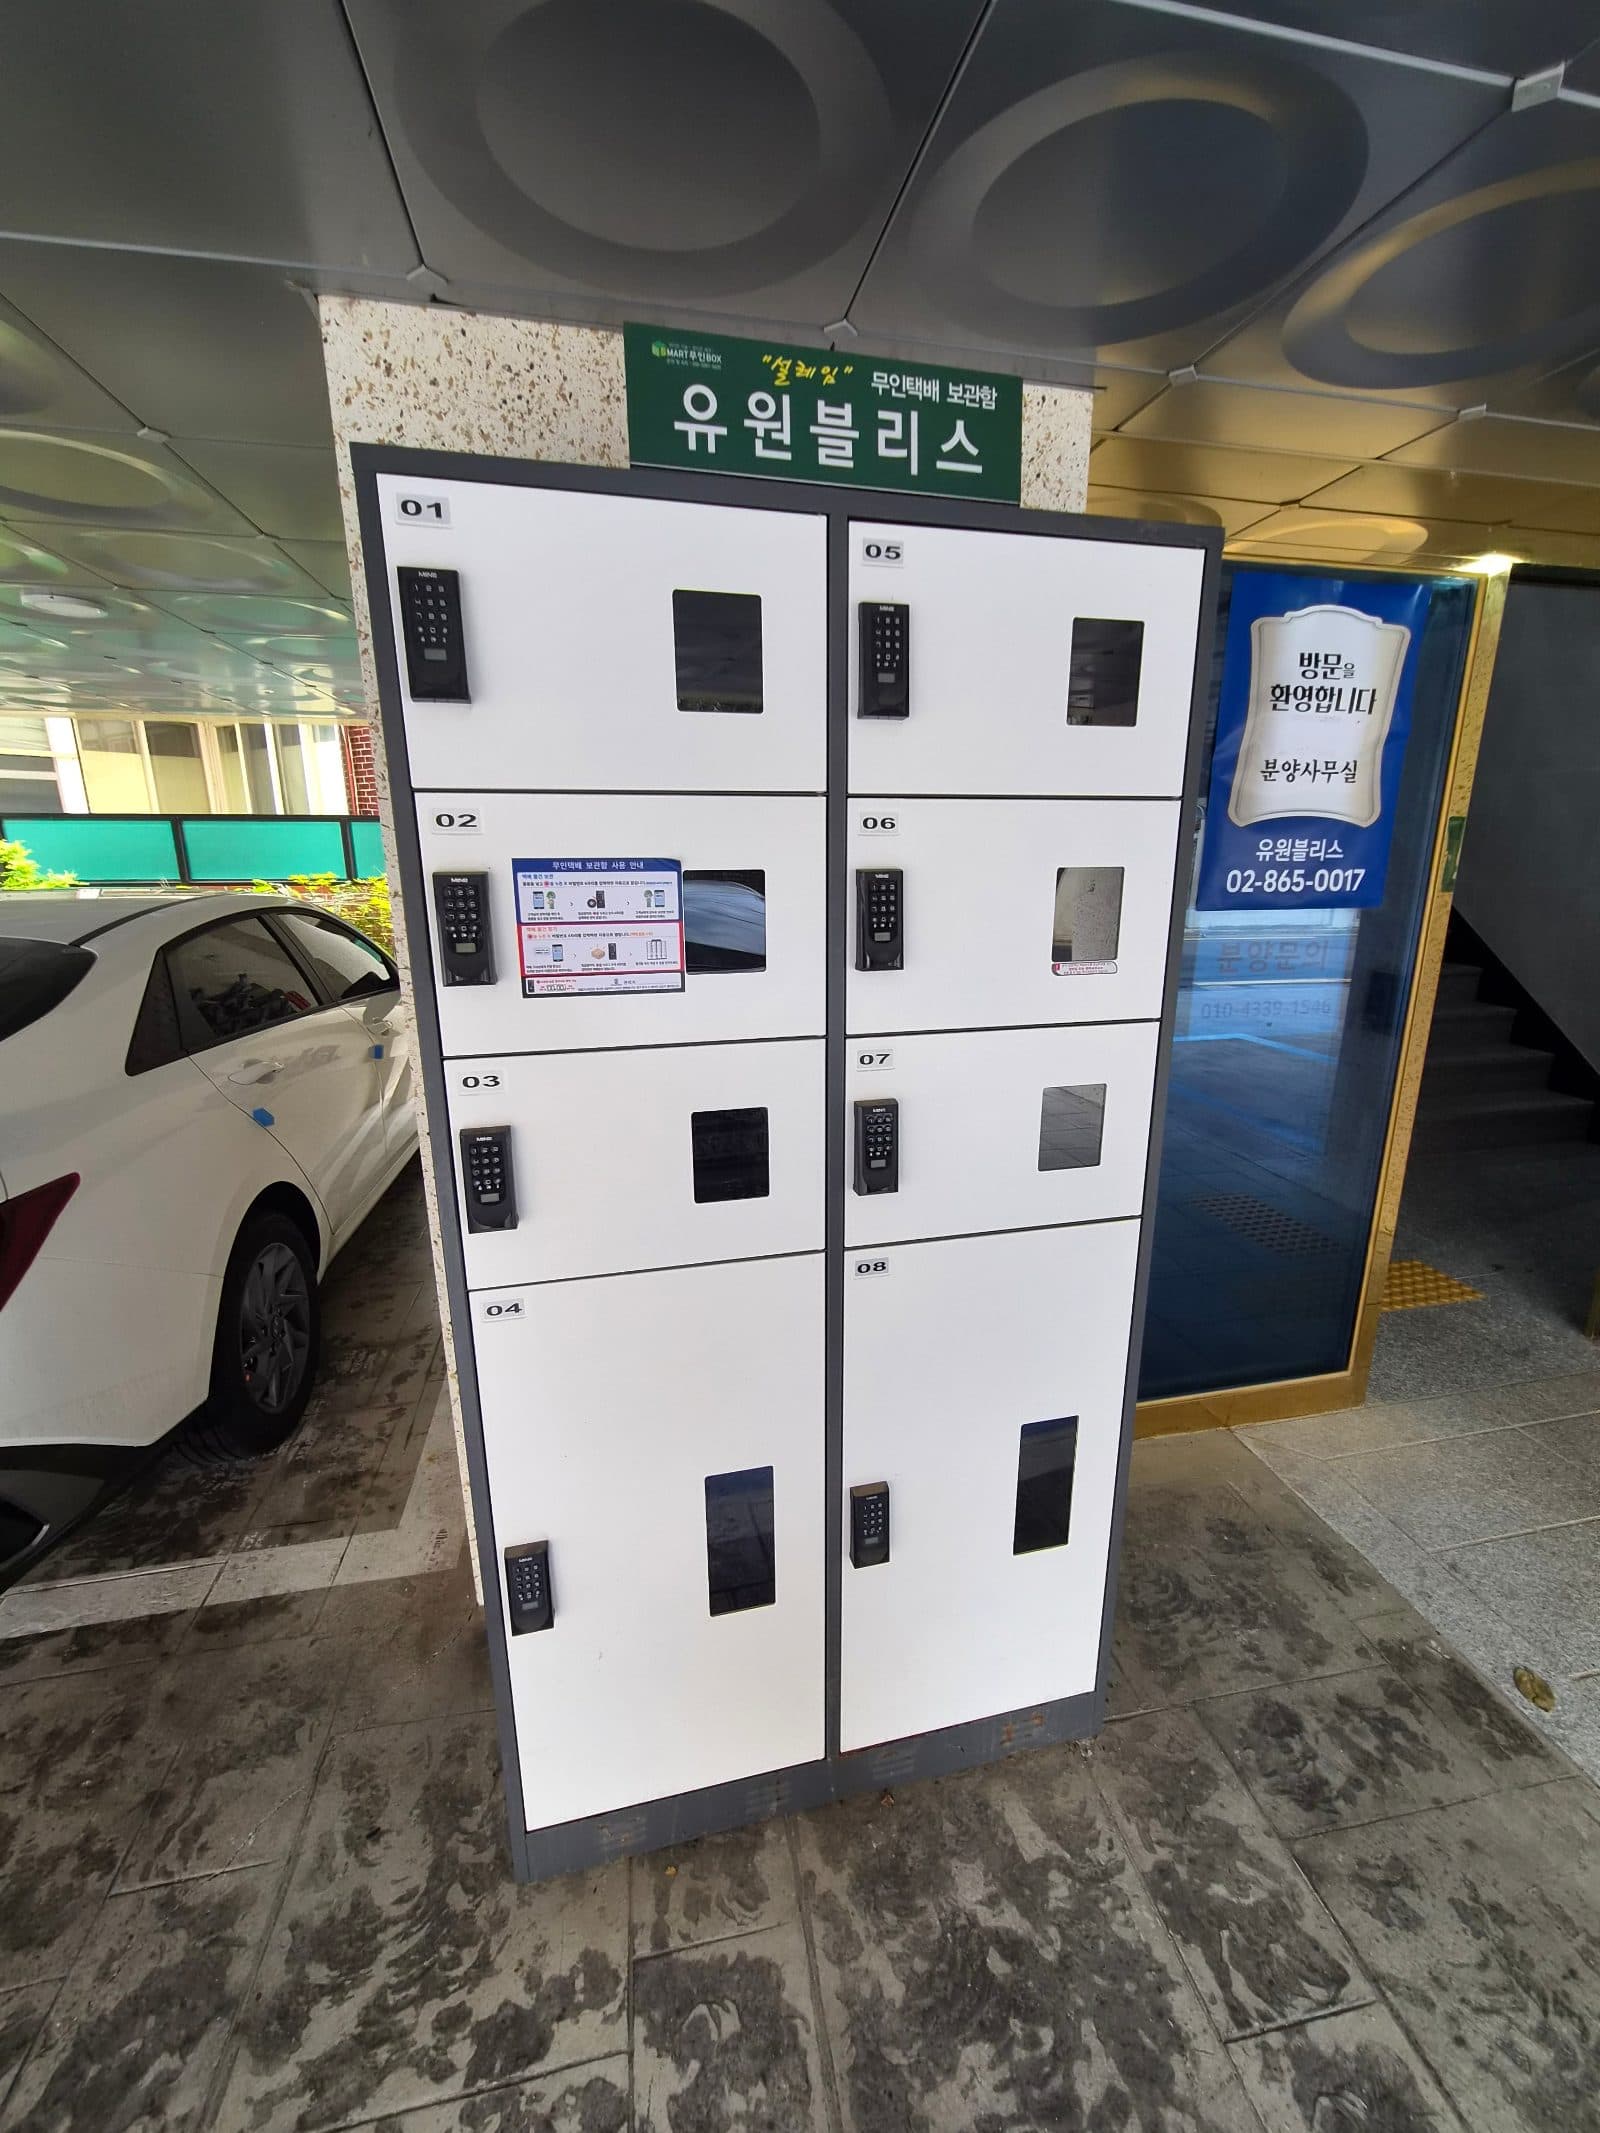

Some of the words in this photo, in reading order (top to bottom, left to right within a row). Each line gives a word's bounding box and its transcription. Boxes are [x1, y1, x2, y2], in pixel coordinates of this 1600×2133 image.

[871, 371, 940, 404] 무인택배
[947, 382, 998, 410] 보관함
[674, 383, 983, 476] 유원블리스
[400, 499, 443, 519] 01
[865, 544, 901, 560] 05
[1299, 652, 1355, 680] 방문을
[1270, 684, 1377, 715] 환영합니다
[1260, 759, 1358, 784] 분양사무실
[435, 813, 478, 828] 02
[862, 817, 896, 830] 06
[1256, 839, 1344, 863] 유원블리스
[552, 861, 582, 871] 무인택배
[586, 861, 608, 870] 보관함
[612, 861, 626, 870] 사용
[629, 861, 644, 870] 안내
[1226, 869, 1366, 893] 02-865-0017
[1217, 939, 1328, 974] 분양문의
[859, 1053, 890, 1065] 07
[462, 1075, 501, 1089] 03
[857, 1261, 886, 1273] 08
[486, 1302, 523, 1316] 04
